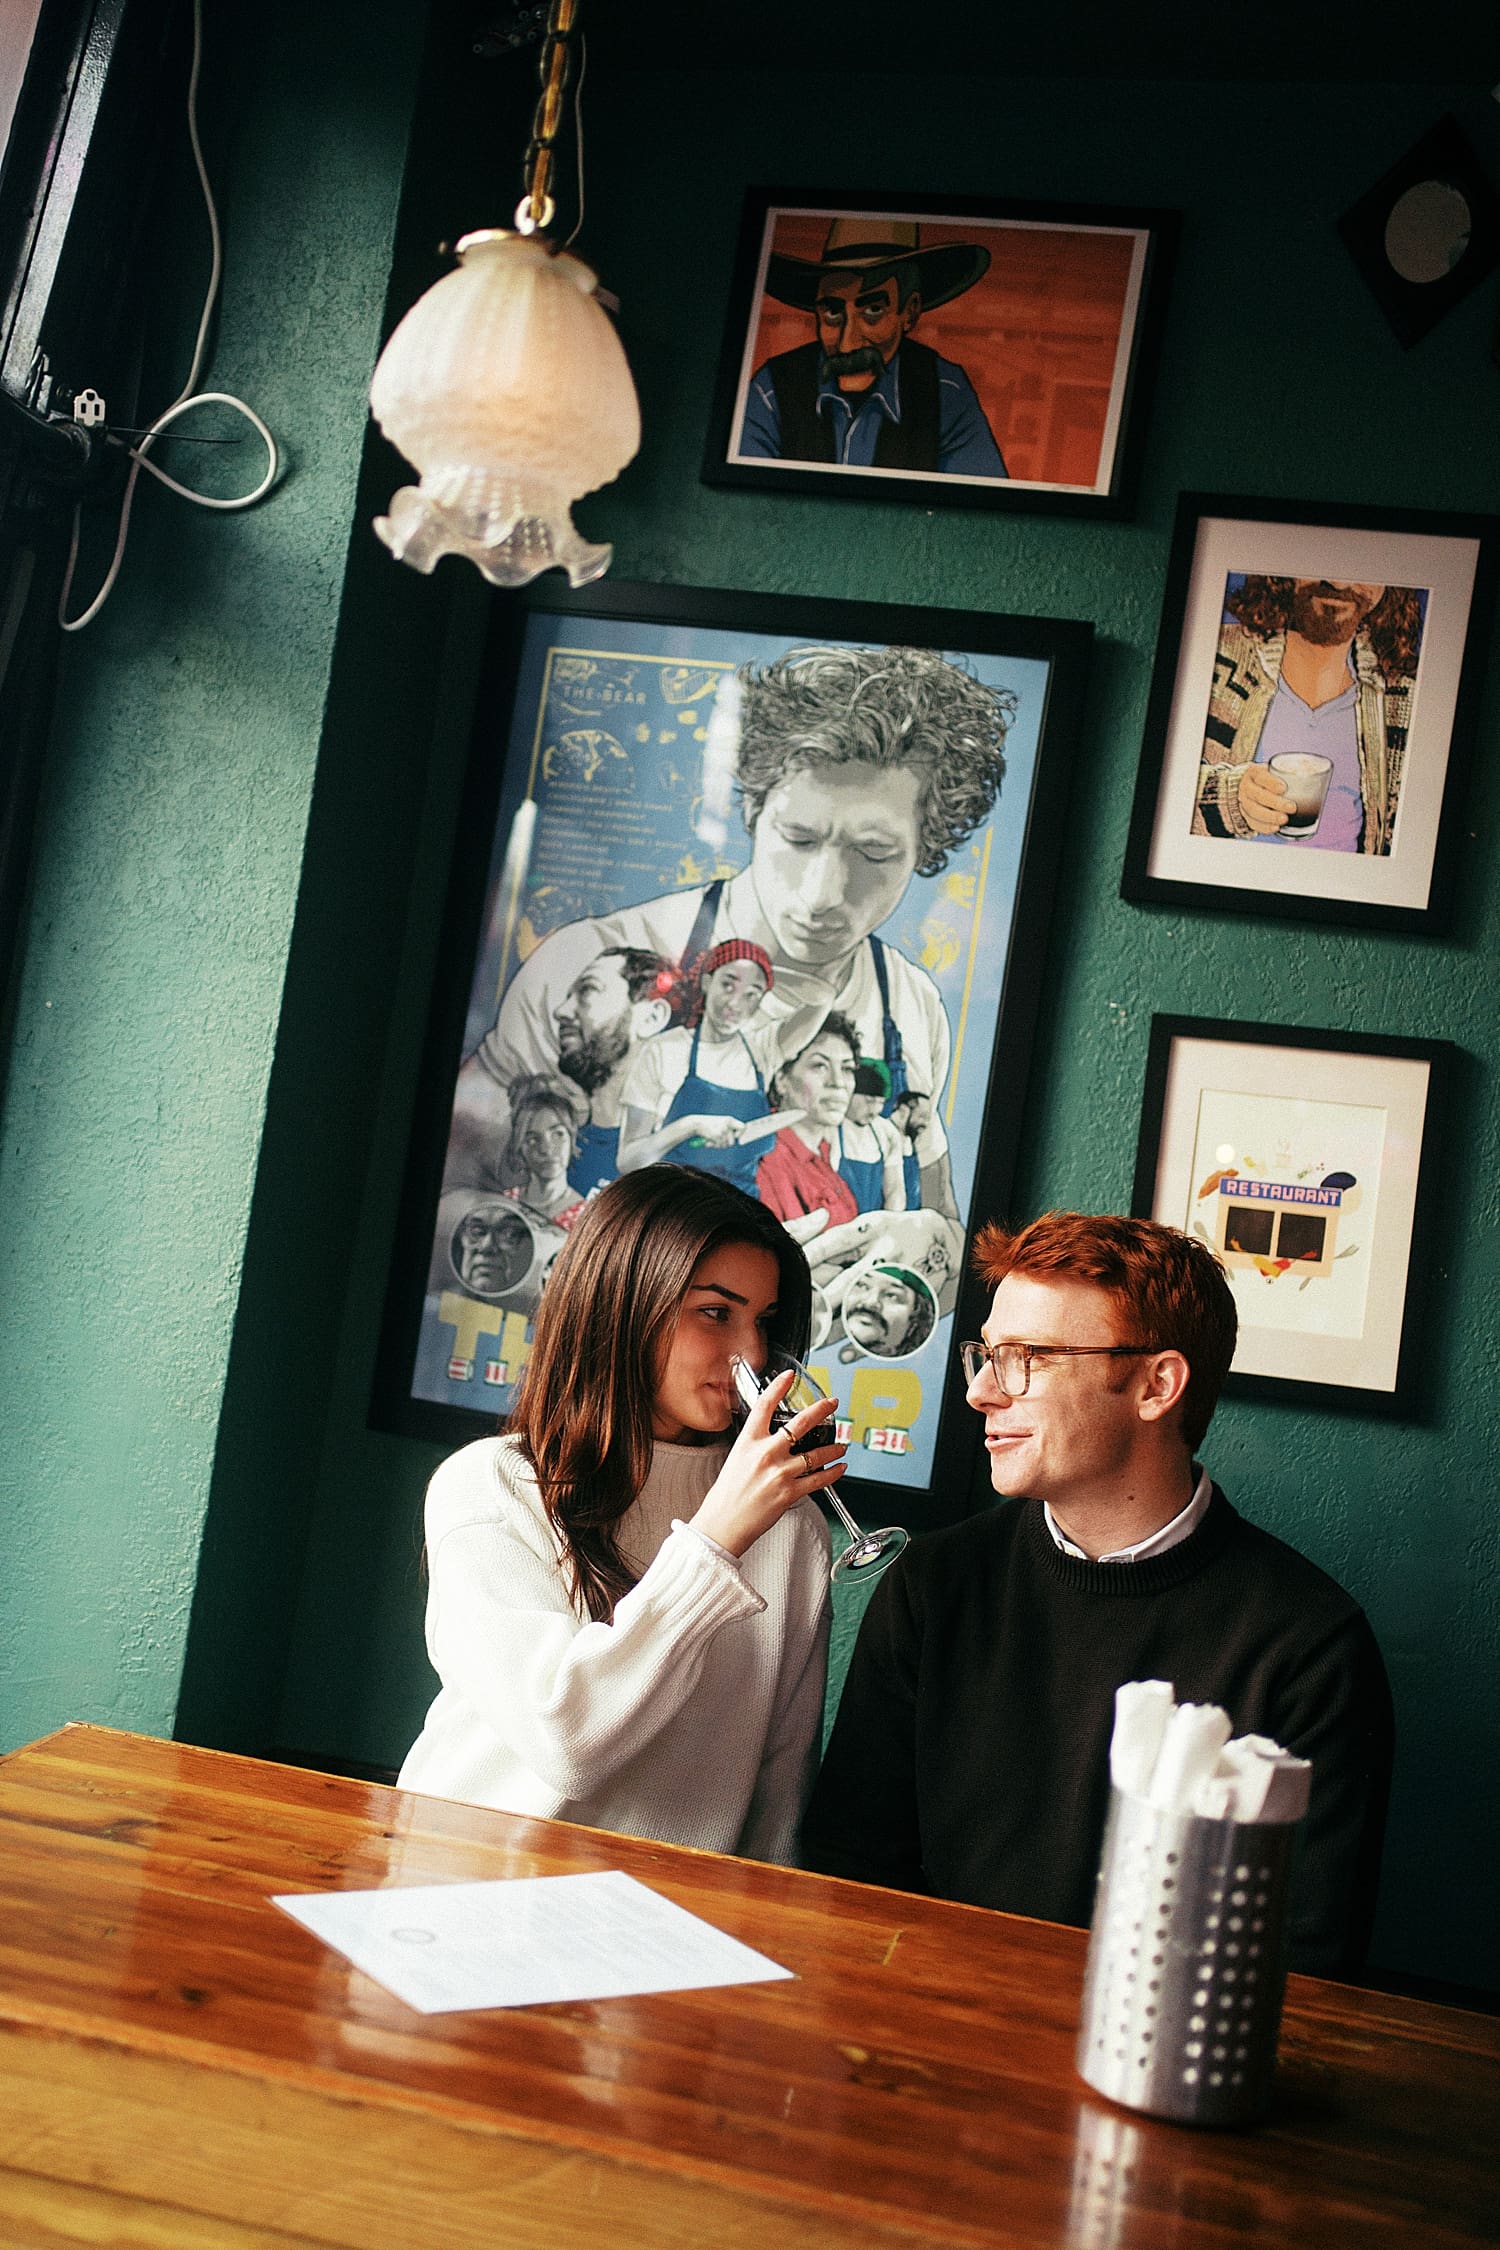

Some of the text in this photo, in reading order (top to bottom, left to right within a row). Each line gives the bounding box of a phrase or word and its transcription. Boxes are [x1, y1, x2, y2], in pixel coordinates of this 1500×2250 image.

[562, 685, 647, 705] THE BEAR
[1227, 1180, 1339, 1205] RESTAURANT
